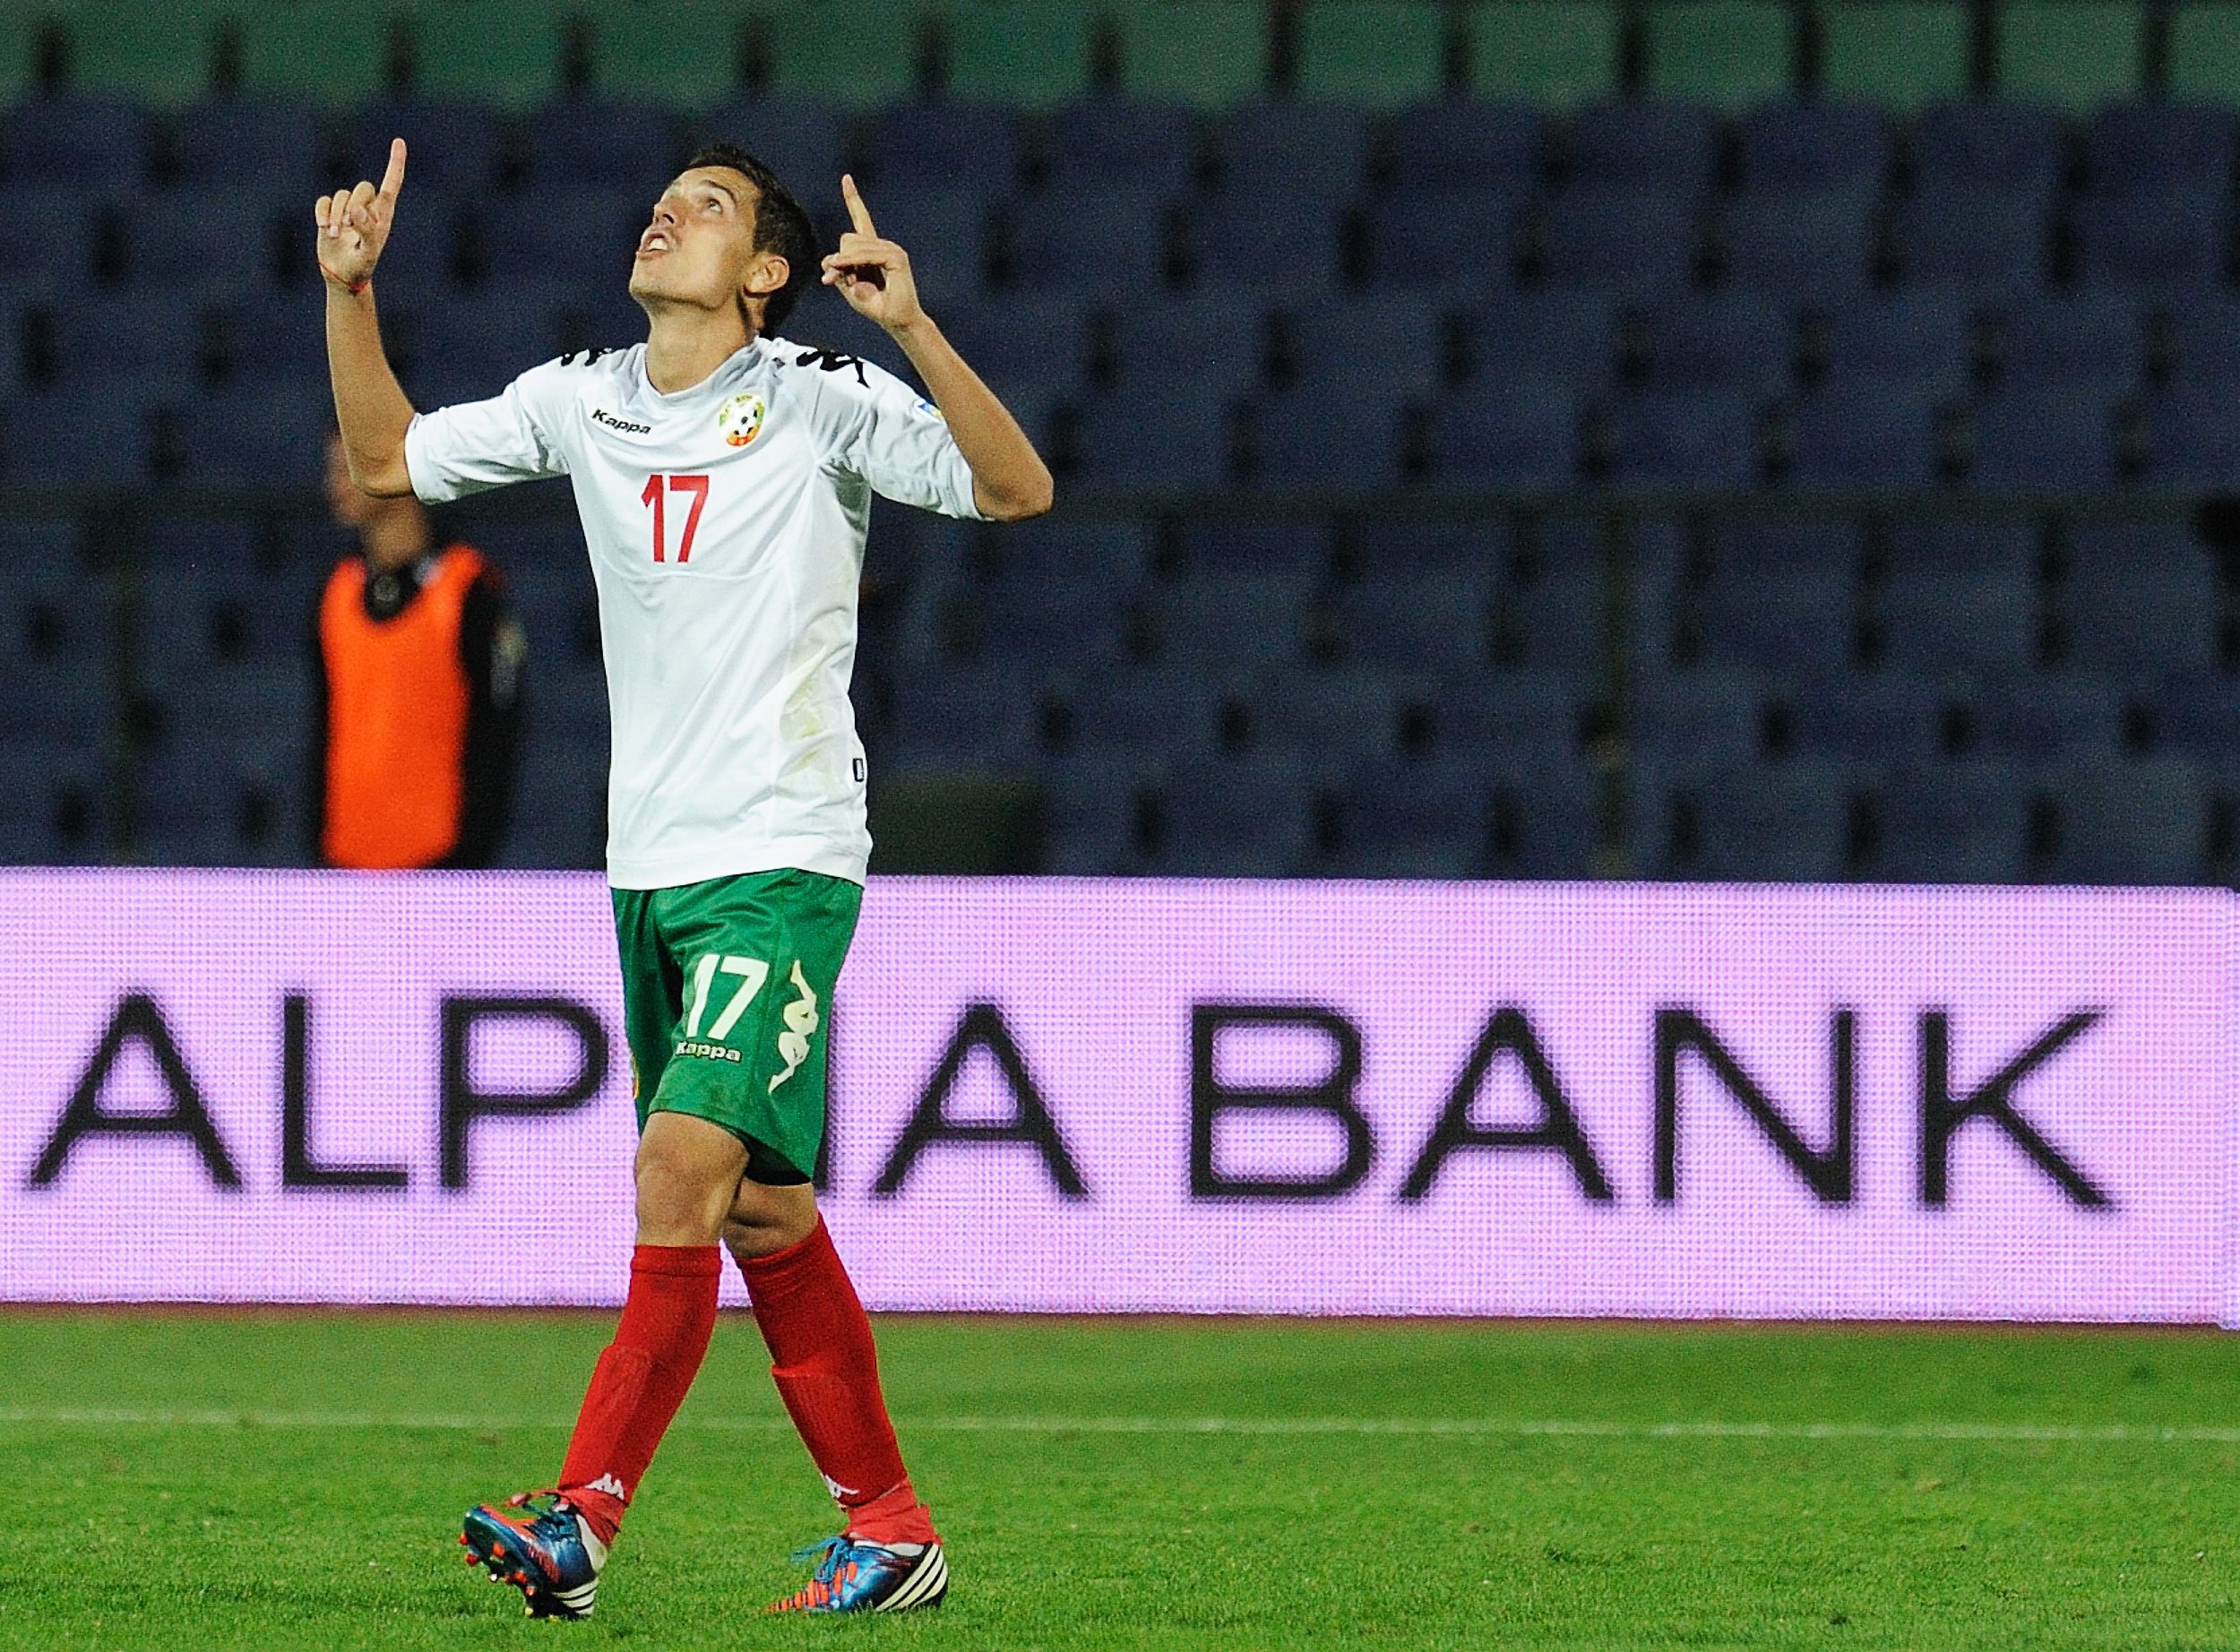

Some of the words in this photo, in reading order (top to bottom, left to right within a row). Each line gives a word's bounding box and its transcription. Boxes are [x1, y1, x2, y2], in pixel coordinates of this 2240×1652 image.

[591, 409, 651, 435] Kappa
[642, 474, 710, 564] 17
[686, 953, 770, 1041] 17
[675, 1040, 742, 1063] Kappa
[27, 988, 1089, 1202] ALPA
[1189, 1002, 2116, 1213] BANK
